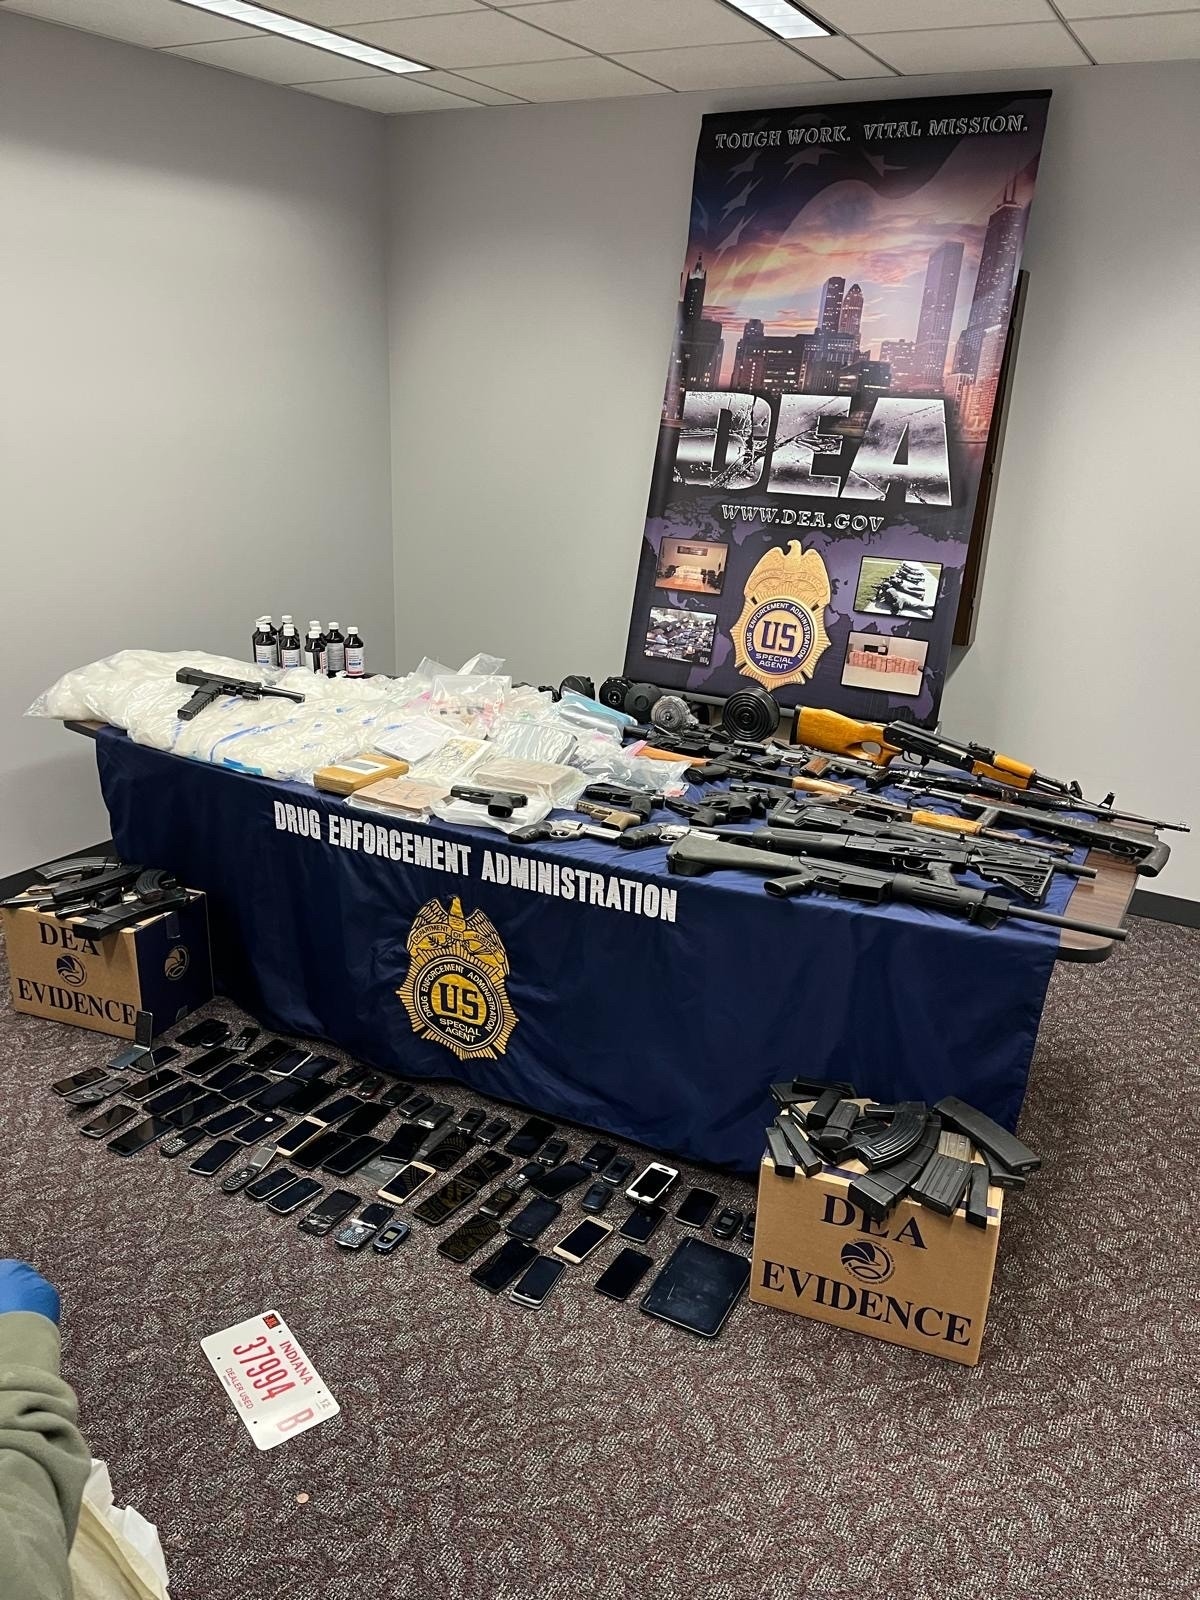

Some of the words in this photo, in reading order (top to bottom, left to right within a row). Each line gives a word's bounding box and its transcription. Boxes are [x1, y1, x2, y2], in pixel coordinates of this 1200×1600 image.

[715, 130, 782, 149] TOUGH
[787, 126, 851, 145] WORK.
[863, 120, 922, 139] VITAL
[927, 114, 1029, 136] MISSION.
[672, 391, 953, 506] DEA
[721, 504, 885, 532] WWW.DEA.GOV
[749, 602, 790, 629] ENFORCEMENT
[790, 606, 811, 660] ADMINISTRATION
[746, 632, 754, 652] DRUG
[761, 621, 797, 651] US
[755, 653, 793, 663] SPECIAL
[758, 660, 789, 670] AGENT
[273, 800, 322, 841] DRUG
[328, 814, 471, 876] ENFORCEMENT
[481, 849, 678, 923] ADMINISTRATION
[38, 921, 100, 956] DEA
[421, 963, 465, 993] ENFORCEMENT
[16, 977, 137, 1026] EVIDENCE
[420, 996, 434, 1018] DRUG
[438, 982, 479, 1021] US
[467, 971, 496, 1032] ADMINISTRATION
[439, 1017, 482, 1037] SPECIAL
[445, 1026, 476, 1043] AGENT
[820, 1193, 928, 1250] DEA
[760, 1259, 972, 1346] EVIDENCE
[279, 1340, 314, 1386] INDIANA
[225, 1367, 243, 1393] DEALER
[239, 1391, 254, 1409] USED
[232, 1336, 296, 1401] 37994
[276, 1407, 314, 1432] B
